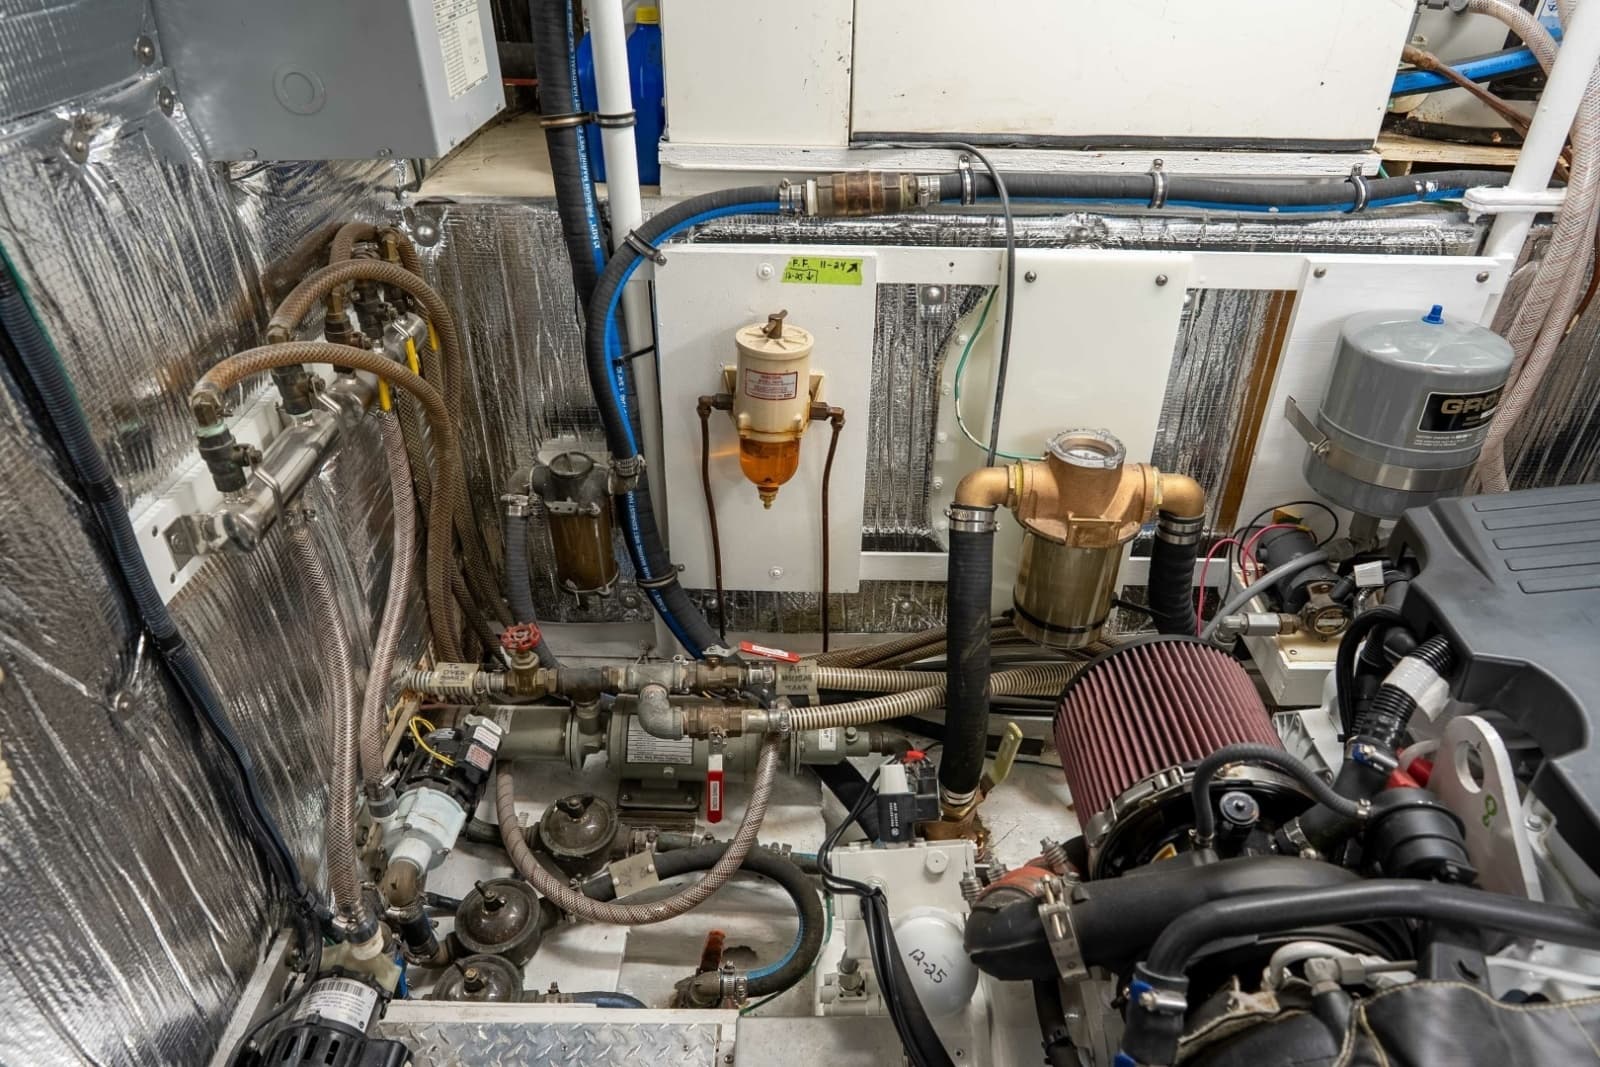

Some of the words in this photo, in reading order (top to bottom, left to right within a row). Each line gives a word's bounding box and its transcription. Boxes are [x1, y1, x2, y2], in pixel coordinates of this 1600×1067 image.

[571, 53, 579, 97] HARDWALL
[581, 153, 589, 182] MARINE
[1441, 393, 1500, 414] GRO
[908, 948, 948, 984] 12-25
